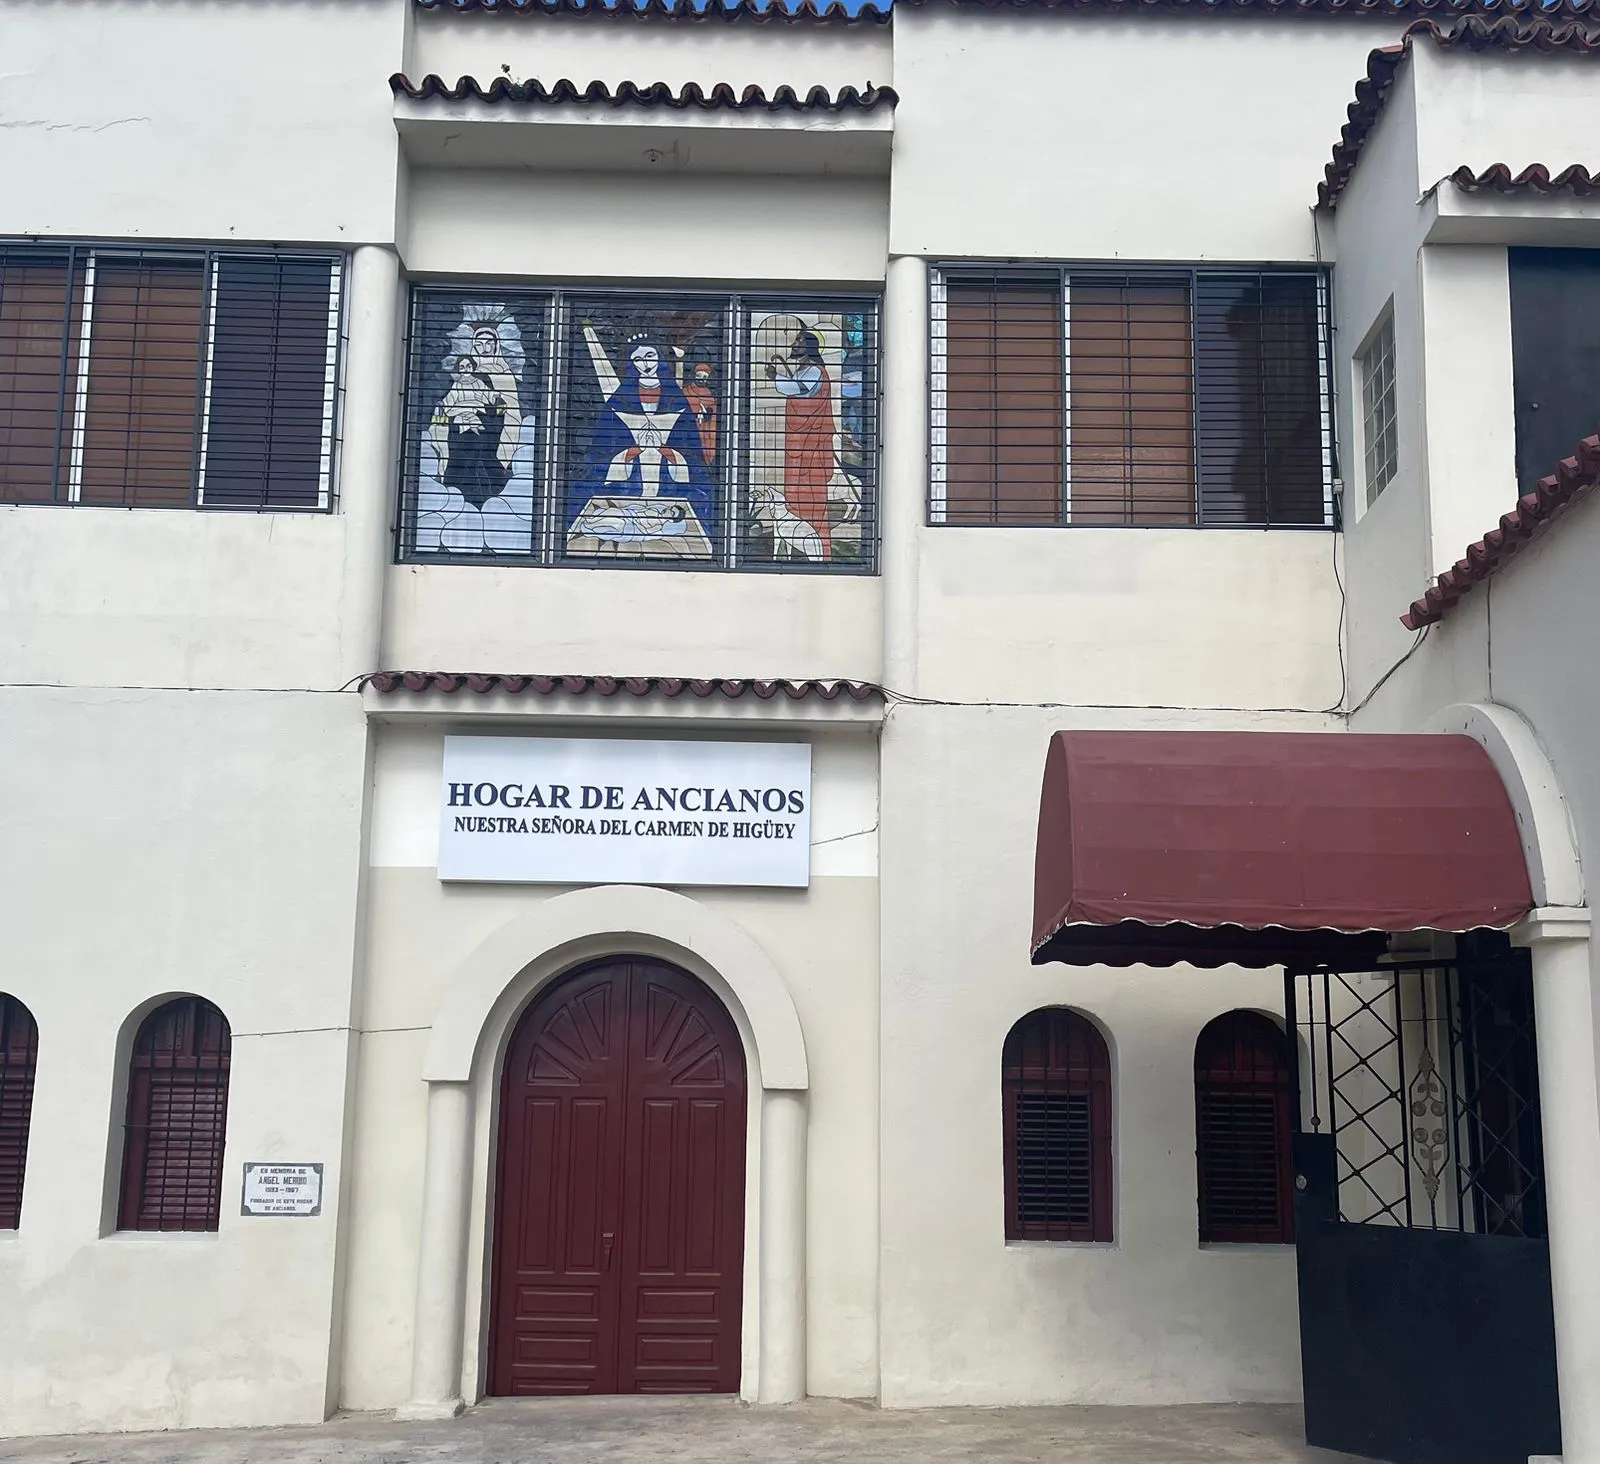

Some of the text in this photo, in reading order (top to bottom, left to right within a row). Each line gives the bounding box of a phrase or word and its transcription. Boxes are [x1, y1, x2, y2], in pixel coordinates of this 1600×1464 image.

[447, 782, 805, 814] HOGAR DE ANCIANOS
[454, 815, 796, 839] NUESTRA SEÑORA DEL CARMEN DE HIGÜEY
